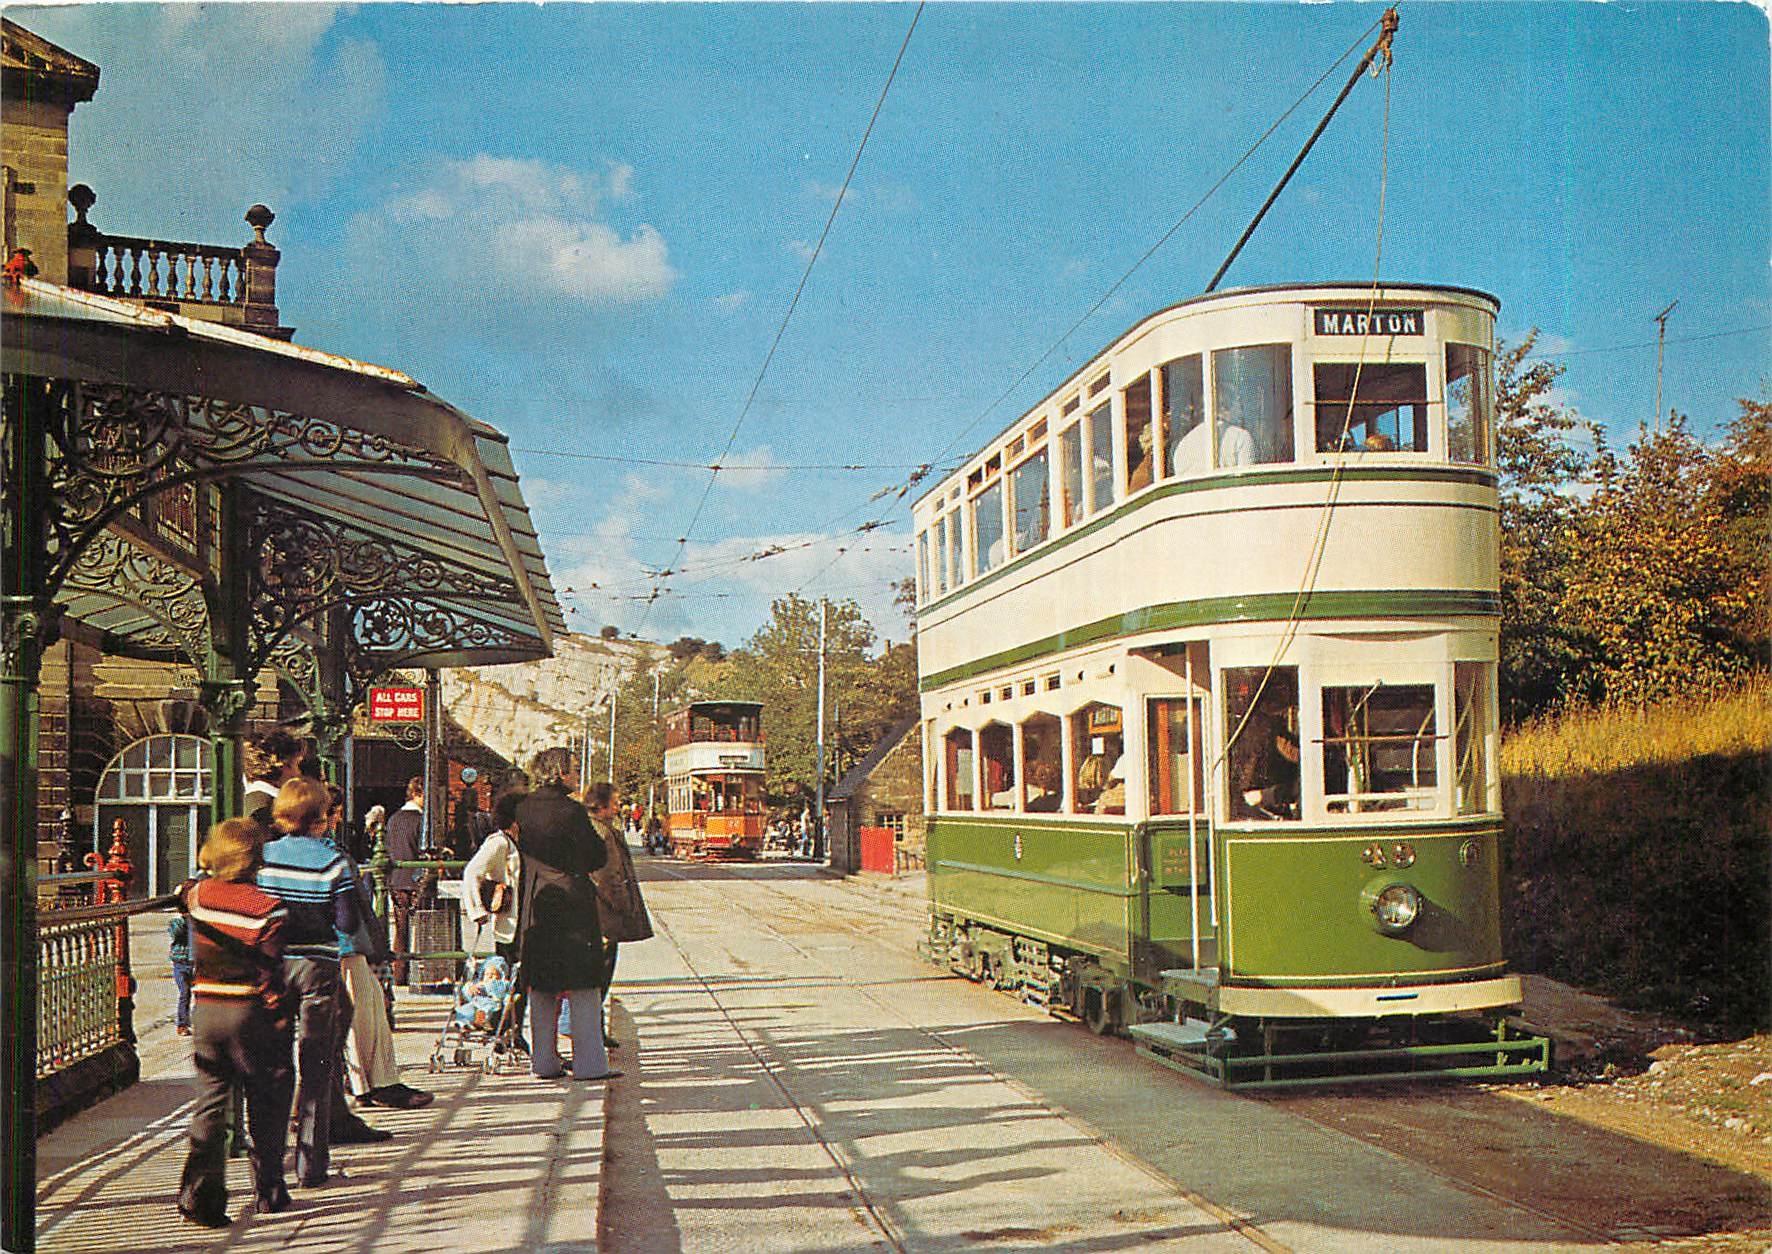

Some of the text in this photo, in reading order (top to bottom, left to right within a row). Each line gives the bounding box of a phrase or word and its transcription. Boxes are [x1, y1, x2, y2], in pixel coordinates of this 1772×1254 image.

[1323, 314, 1416, 334] MARTON
[376, 692, 417, 703] ALL CARS
[375, 707, 419, 718] STOP HERE
